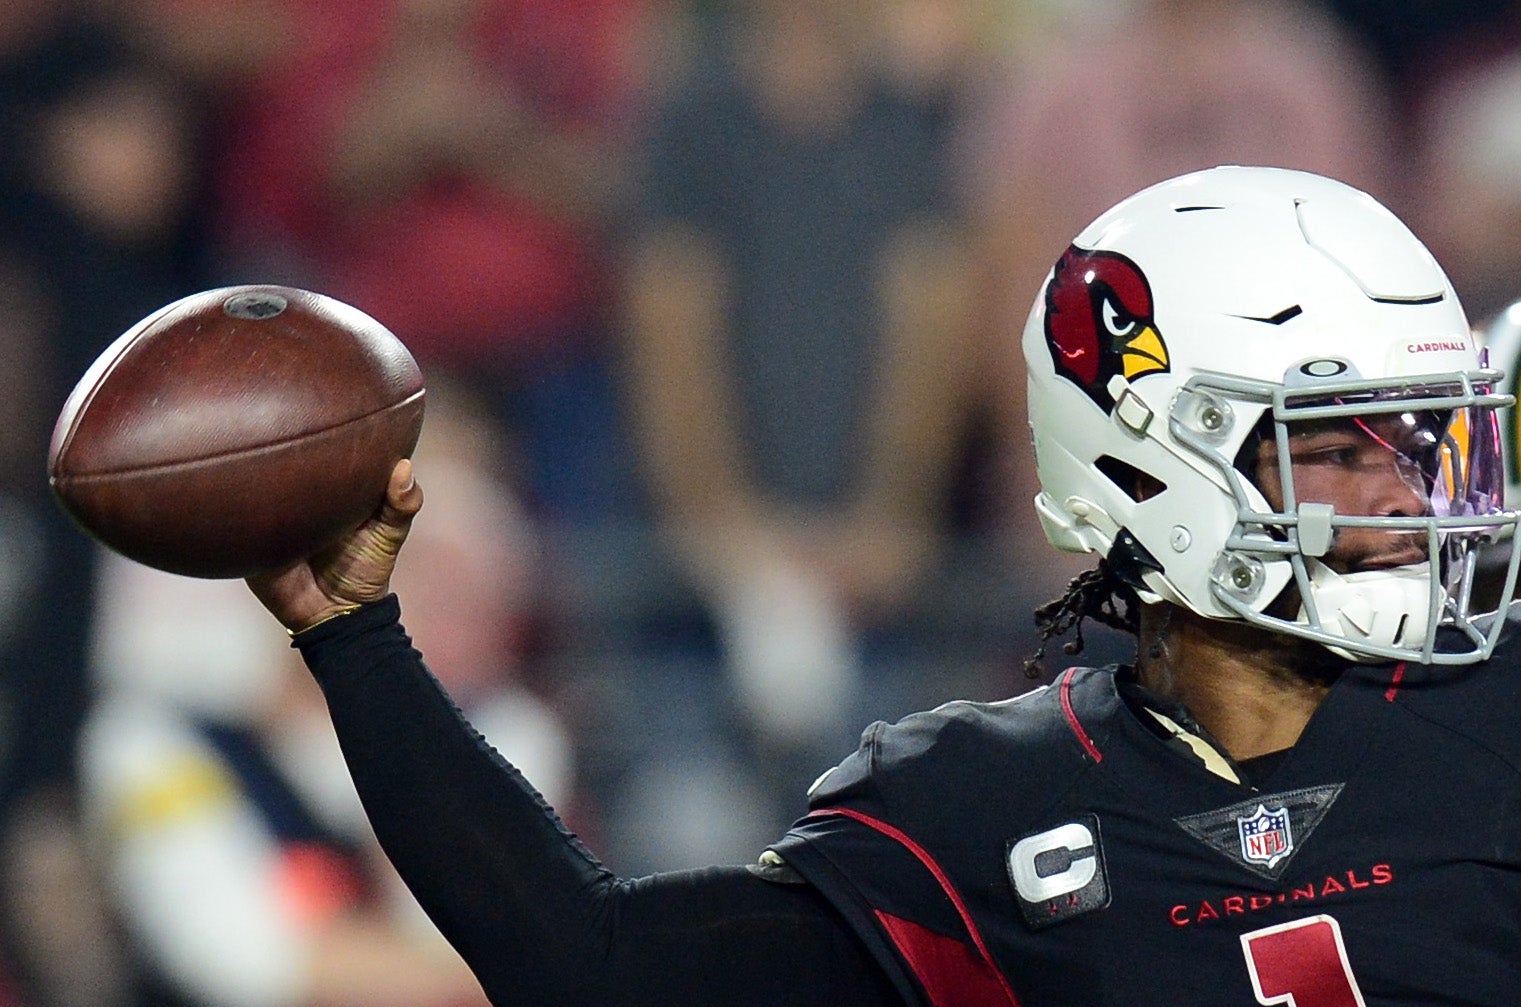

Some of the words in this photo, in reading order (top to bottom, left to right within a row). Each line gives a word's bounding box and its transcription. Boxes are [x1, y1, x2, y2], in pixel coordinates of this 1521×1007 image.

[1407, 341, 1467, 354] CARDINALS
[1249, 830, 1285, 857] NFL
[1010, 823, 1097, 904] C
